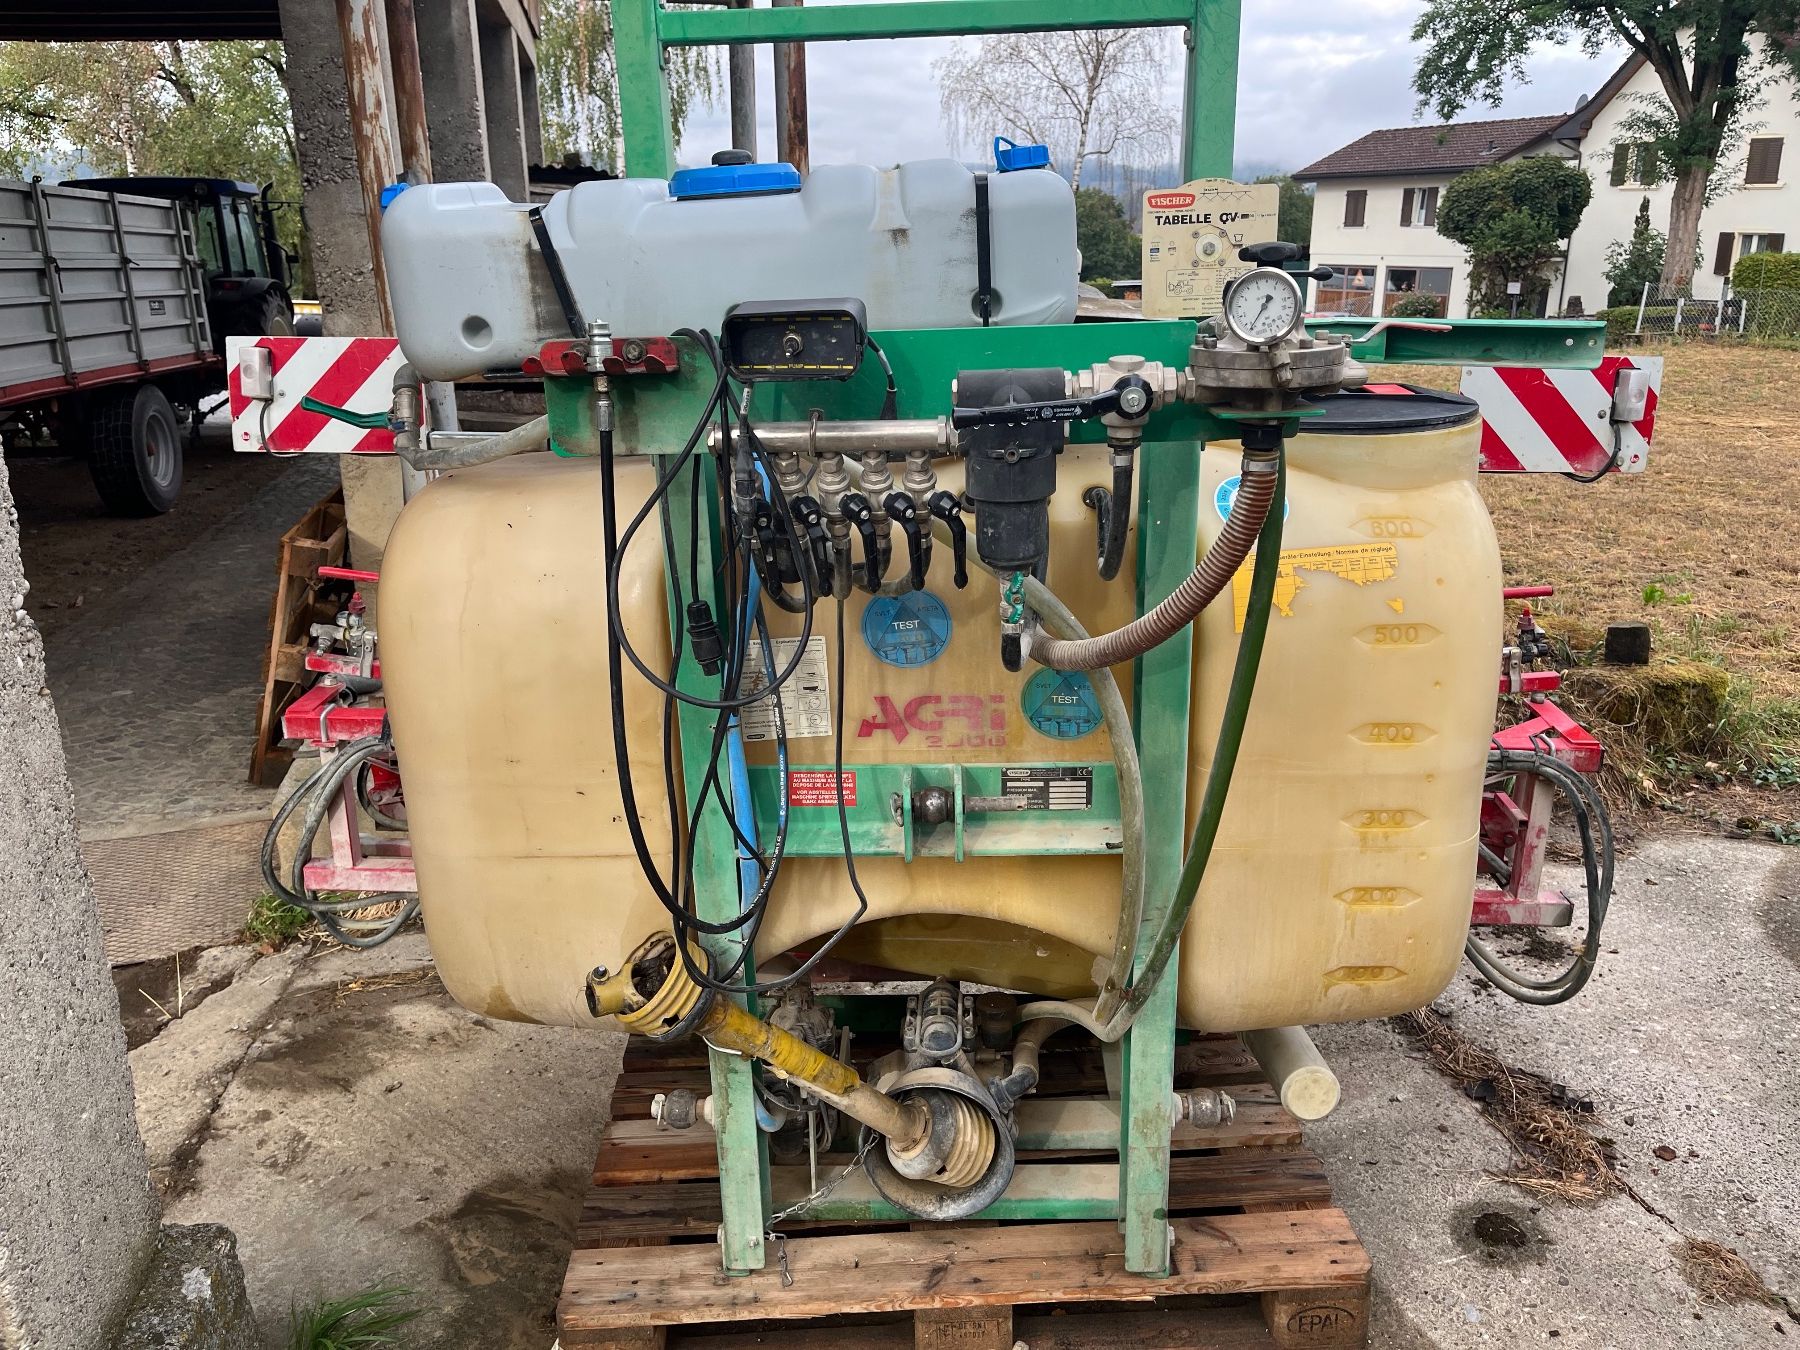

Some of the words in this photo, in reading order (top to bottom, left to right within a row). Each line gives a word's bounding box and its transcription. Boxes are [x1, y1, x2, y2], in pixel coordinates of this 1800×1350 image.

[1151, 196, 1192, 205] FISCHER
[1155, 214, 1211, 225] TABELLE
[1371, 520, 1414, 538] 600
[1279, 549, 1331, 561] eräte-Einstellung
[1370, 546, 1393, 554] réglage
[892, 619, 920, 631] TEST
[1375, 625, 1419, 643] 500
[1051, 695, 1079, 704] TEST
[1370, 726, 1414, 742] 400
[1361, 810, 1405, 826] 300
